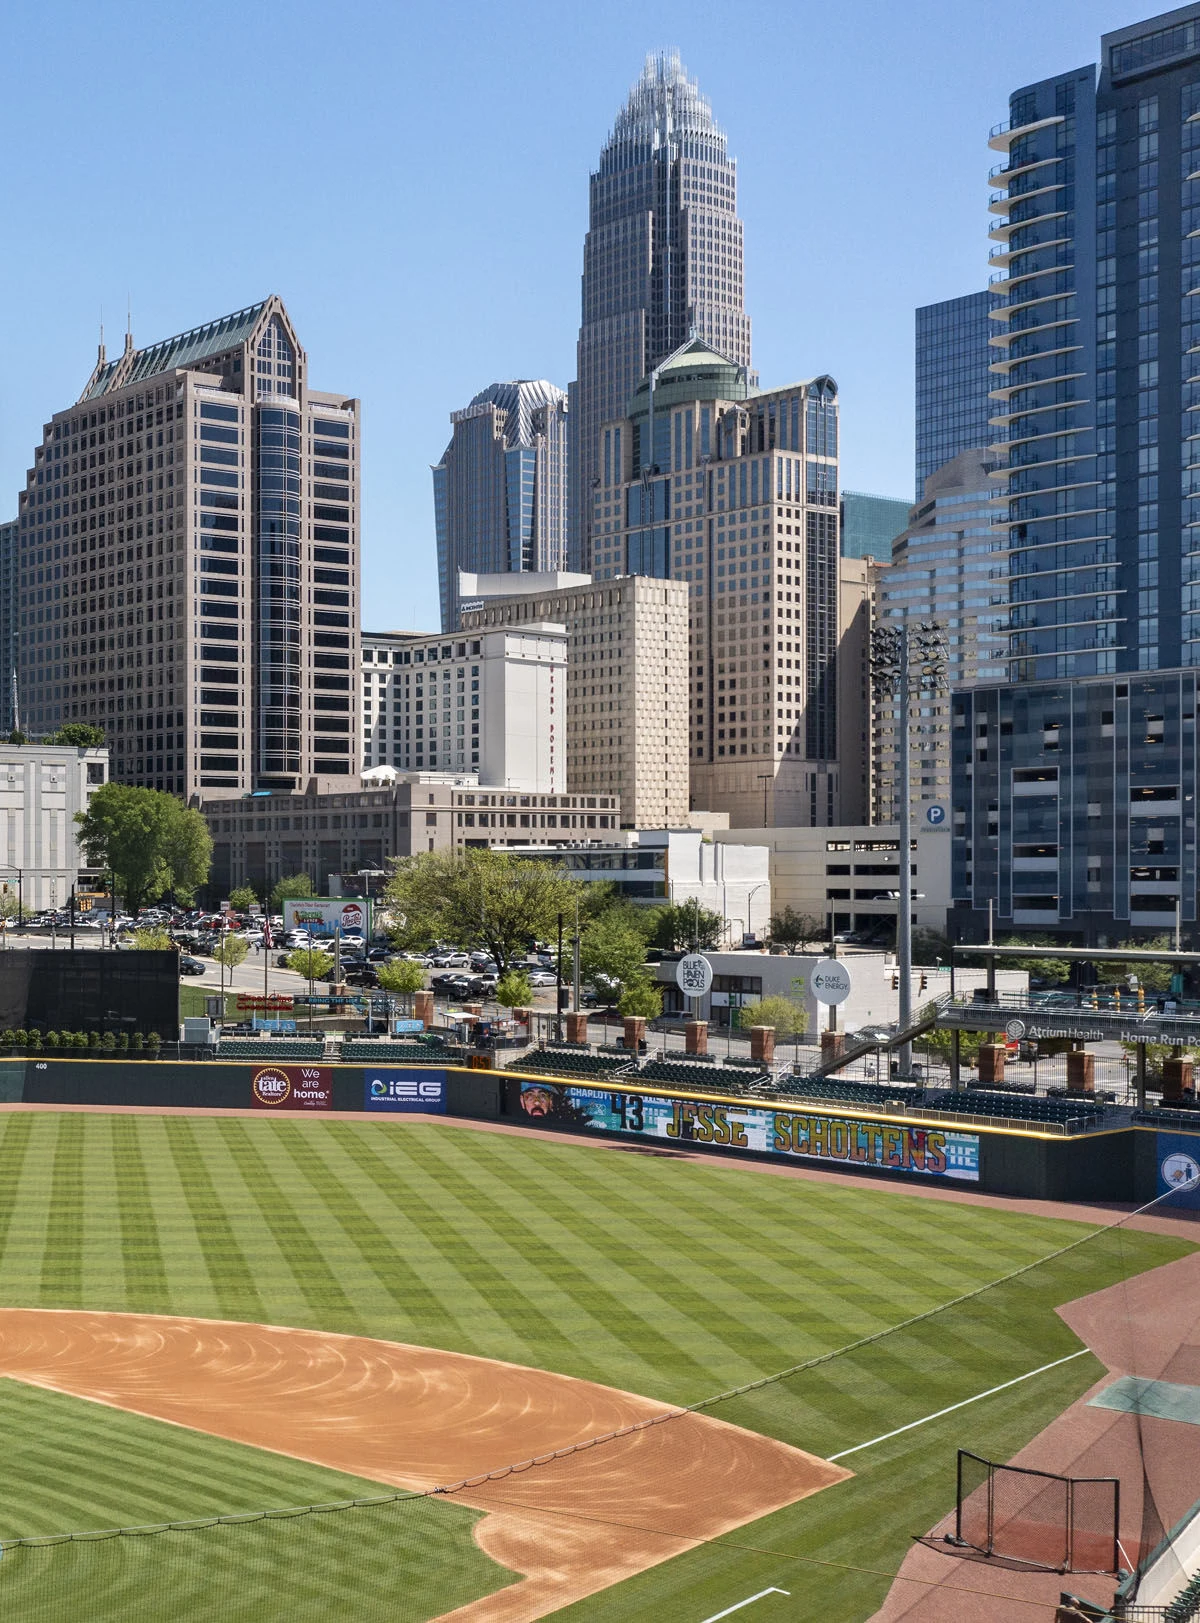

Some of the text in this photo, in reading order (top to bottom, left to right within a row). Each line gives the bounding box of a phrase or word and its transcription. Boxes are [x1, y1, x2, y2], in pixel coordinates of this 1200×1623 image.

[450, 403, 492, 422] TRUIST
[683, 961, 697, 970] BLUE
[683, 970, 705, 979] HAVEN
[683, 979, 705, 988] POOLS
[1029, 1026, 1104, 1041] Atrium Health
[1121, 1032, 1157, 1044] Home
[1161, 1034, 1184, 1046] Run
[302, 1069, 320, 1078] We
[257, 1077, 287, 1092] tate
[611, 1094, 644, 1132] 43
[666, 1101, 947, 1173] JESSE SCHOLTENS
